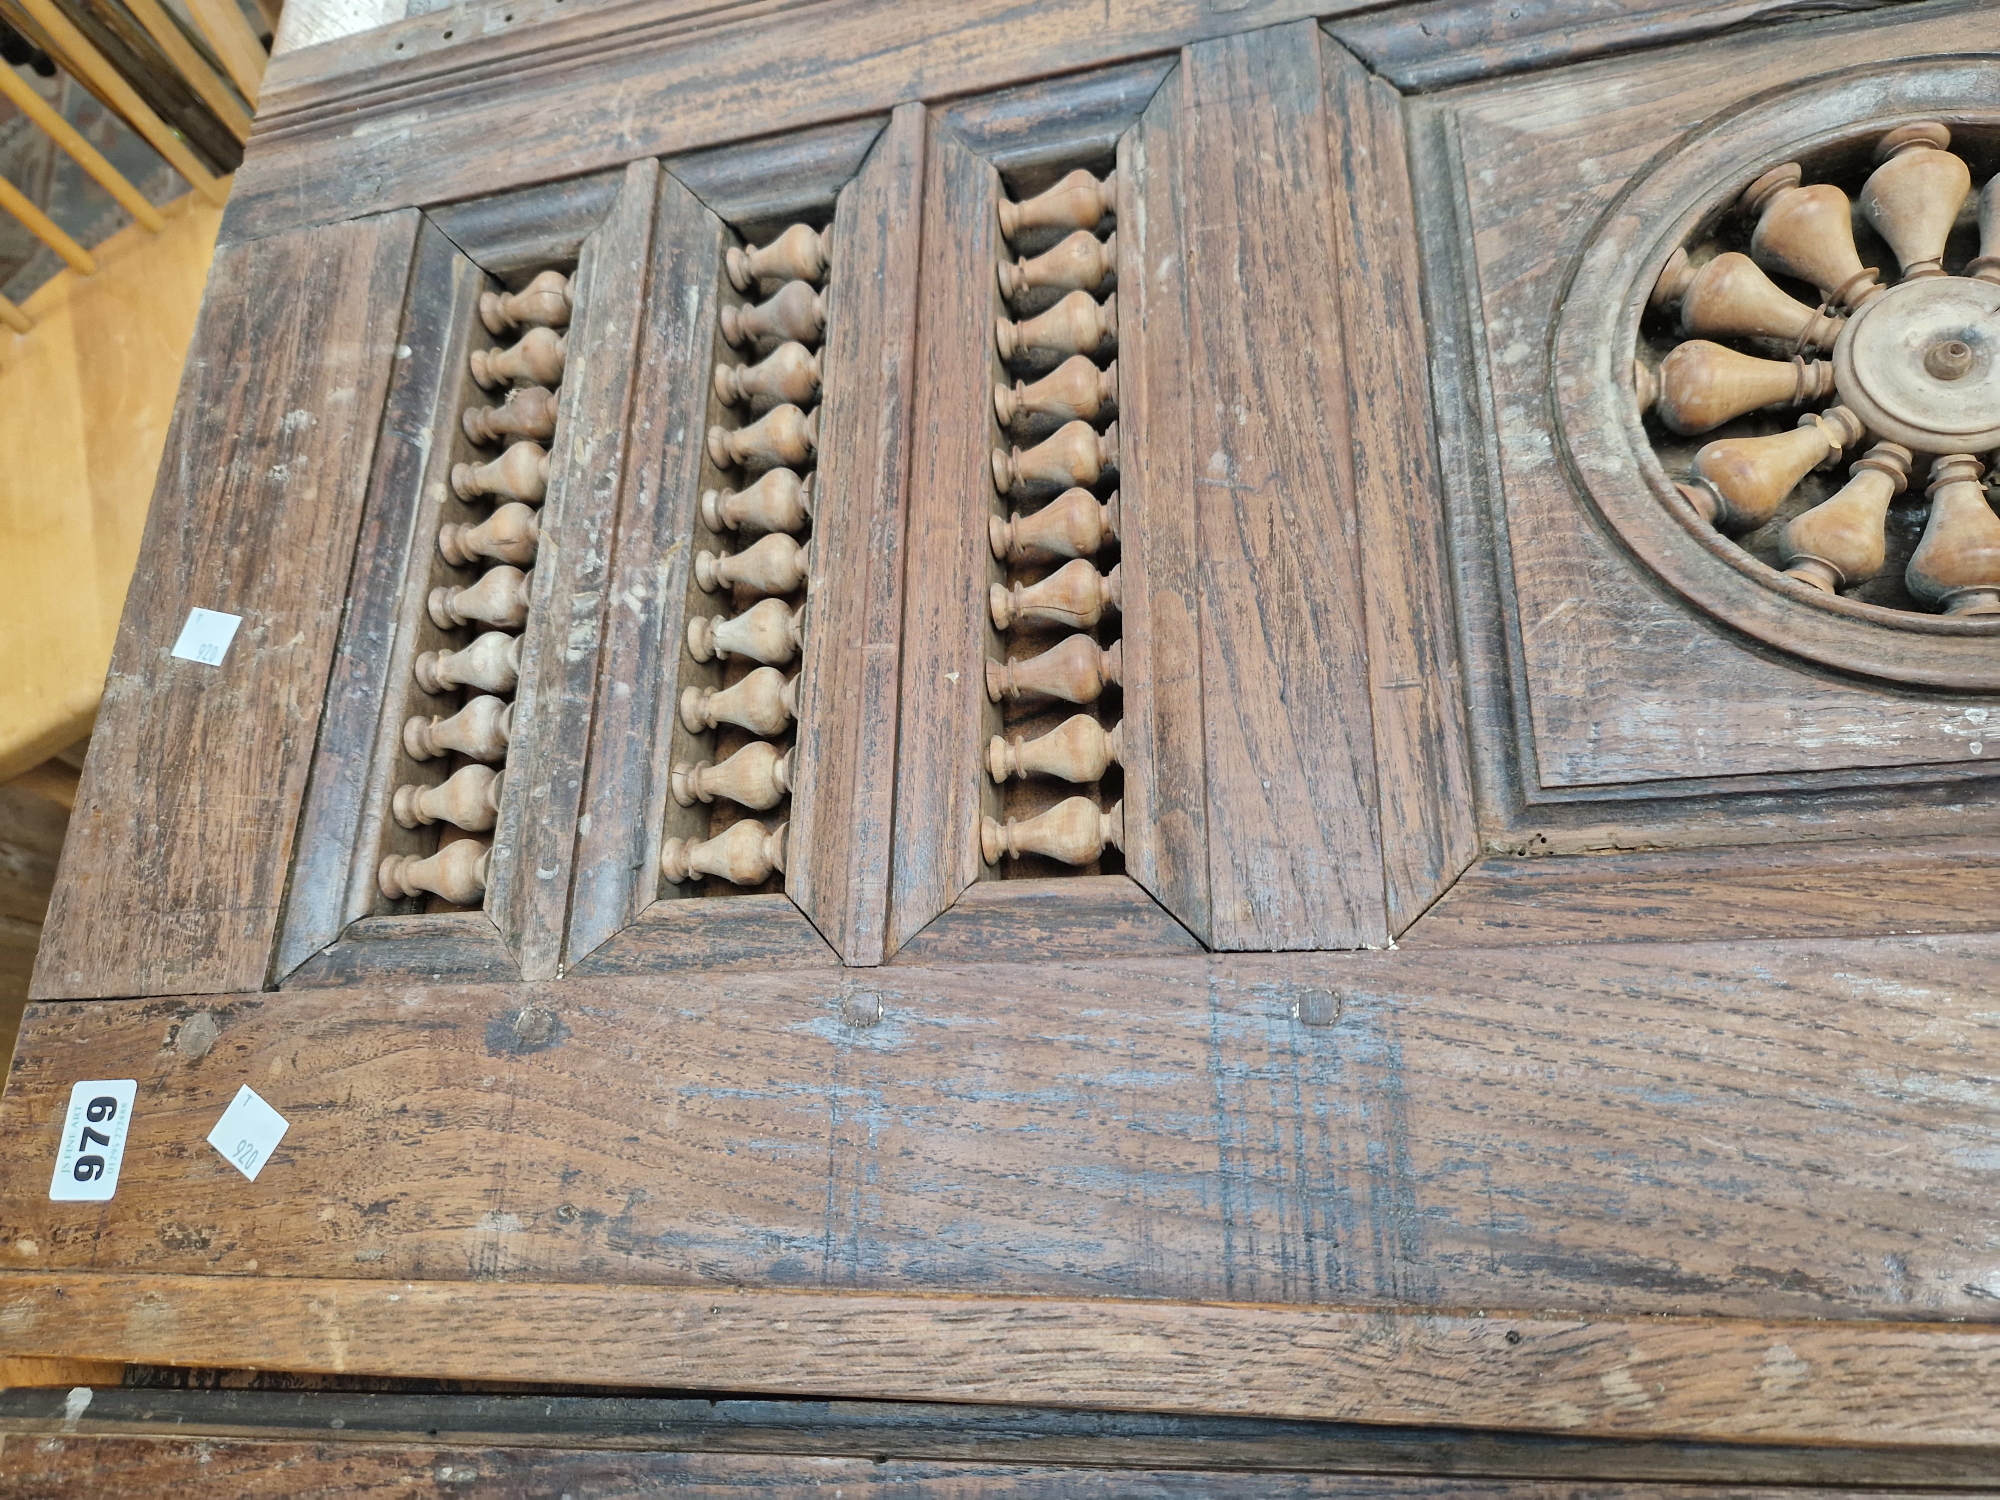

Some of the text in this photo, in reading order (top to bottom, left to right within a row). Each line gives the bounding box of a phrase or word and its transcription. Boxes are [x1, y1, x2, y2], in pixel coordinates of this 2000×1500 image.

[196, 643, 219, 663] 920
[243, 1093, 253, 1107] T
[61, 1106, 82, 1173] JS FINE ART
[73, 1096, 118, 1182] 979
[232, 1138, 259, 1170] 920
[107, 1143, 119, 1174] 01295
